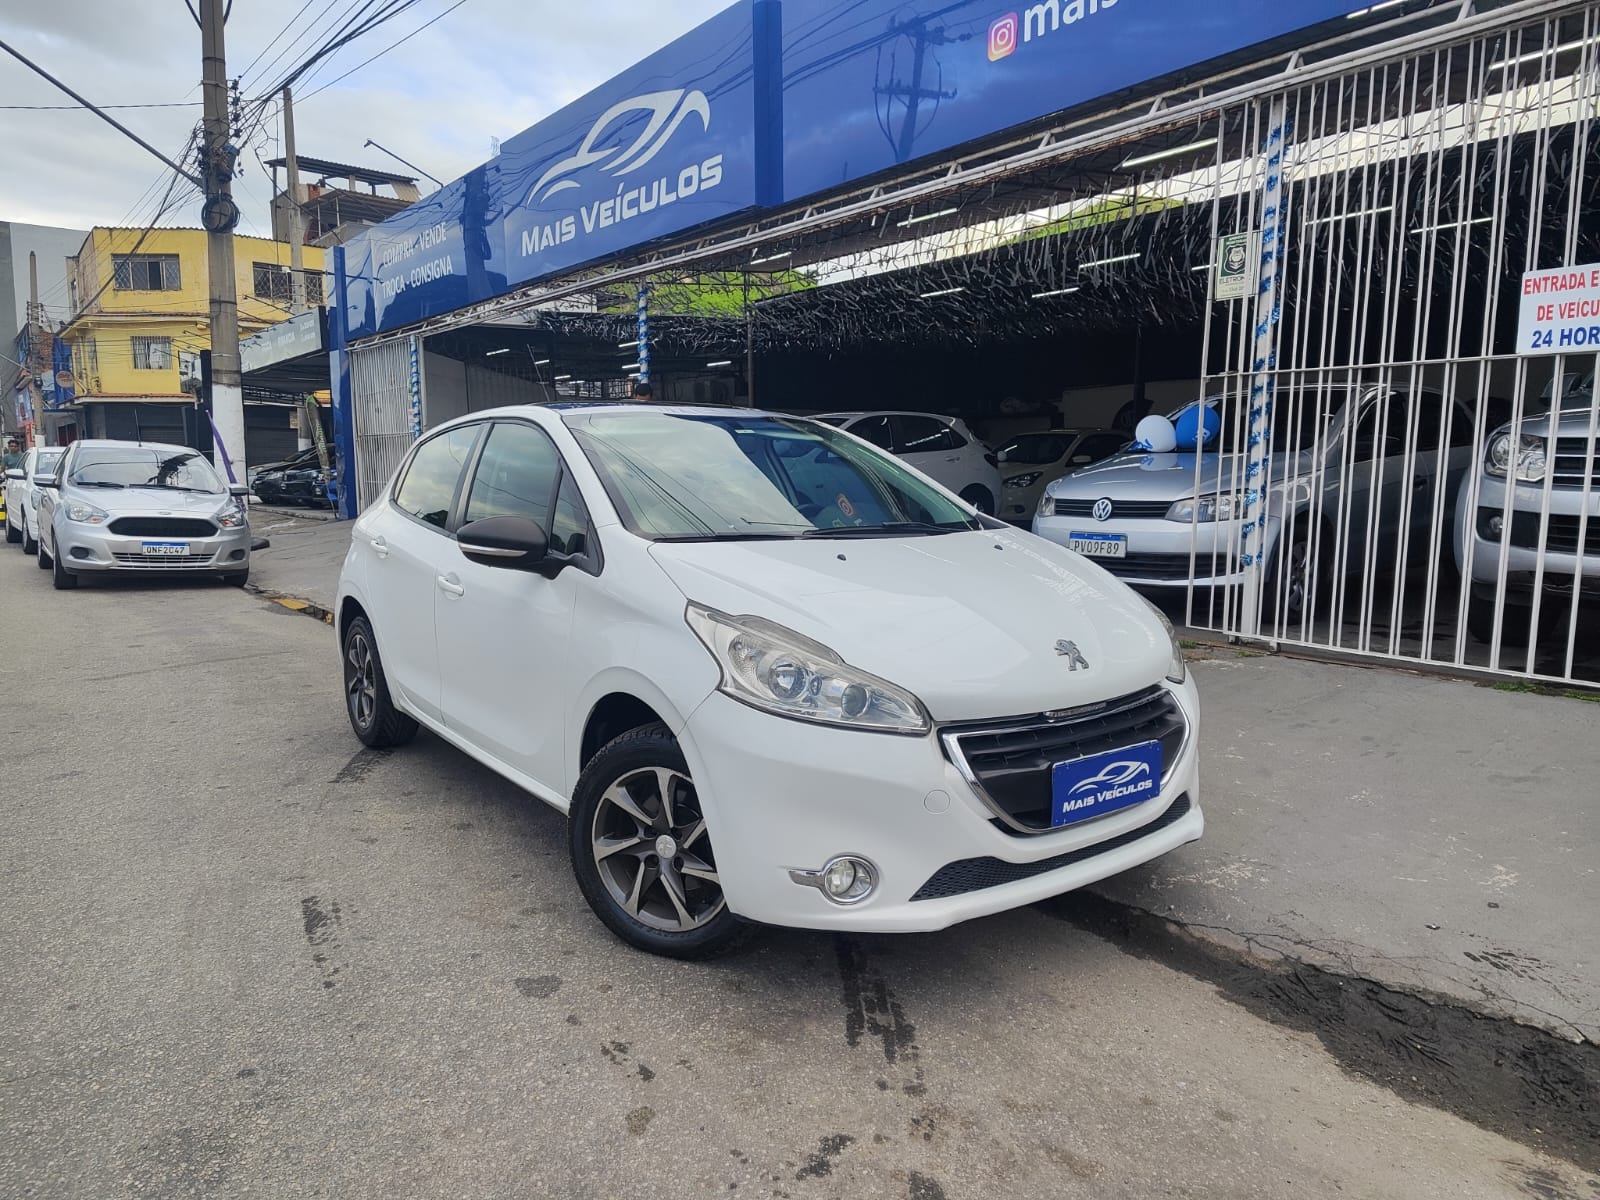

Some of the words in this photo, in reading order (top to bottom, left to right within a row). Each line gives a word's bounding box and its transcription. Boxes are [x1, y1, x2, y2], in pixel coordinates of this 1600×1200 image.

[1024, 0, 1118, 42] ma
[521, 215, 576, 256] MAIS
[580, 154, 723, 234] VEÍCULOS
[383, 239, 414, 268] COMPRA
[419, 222, 447, 251] VENDE
[382, 274, 406, 299] TROCA
[410, 255, 453, 288] CONSIGNA
[1523, 272, 1586, 295] ENTRADA
[1590, 270, 1599, 288] E
[1536, 304, 1554, 321] DE
[1558, 298, 1600, 319] VEÍCU
[1531, 329, 1553, 348] 24
[1559, 326, 1600, 346] HOR
[1062, 795, 1095, 813] MAIS
[1096, 779, 1153, 803] VEÍCULOS
